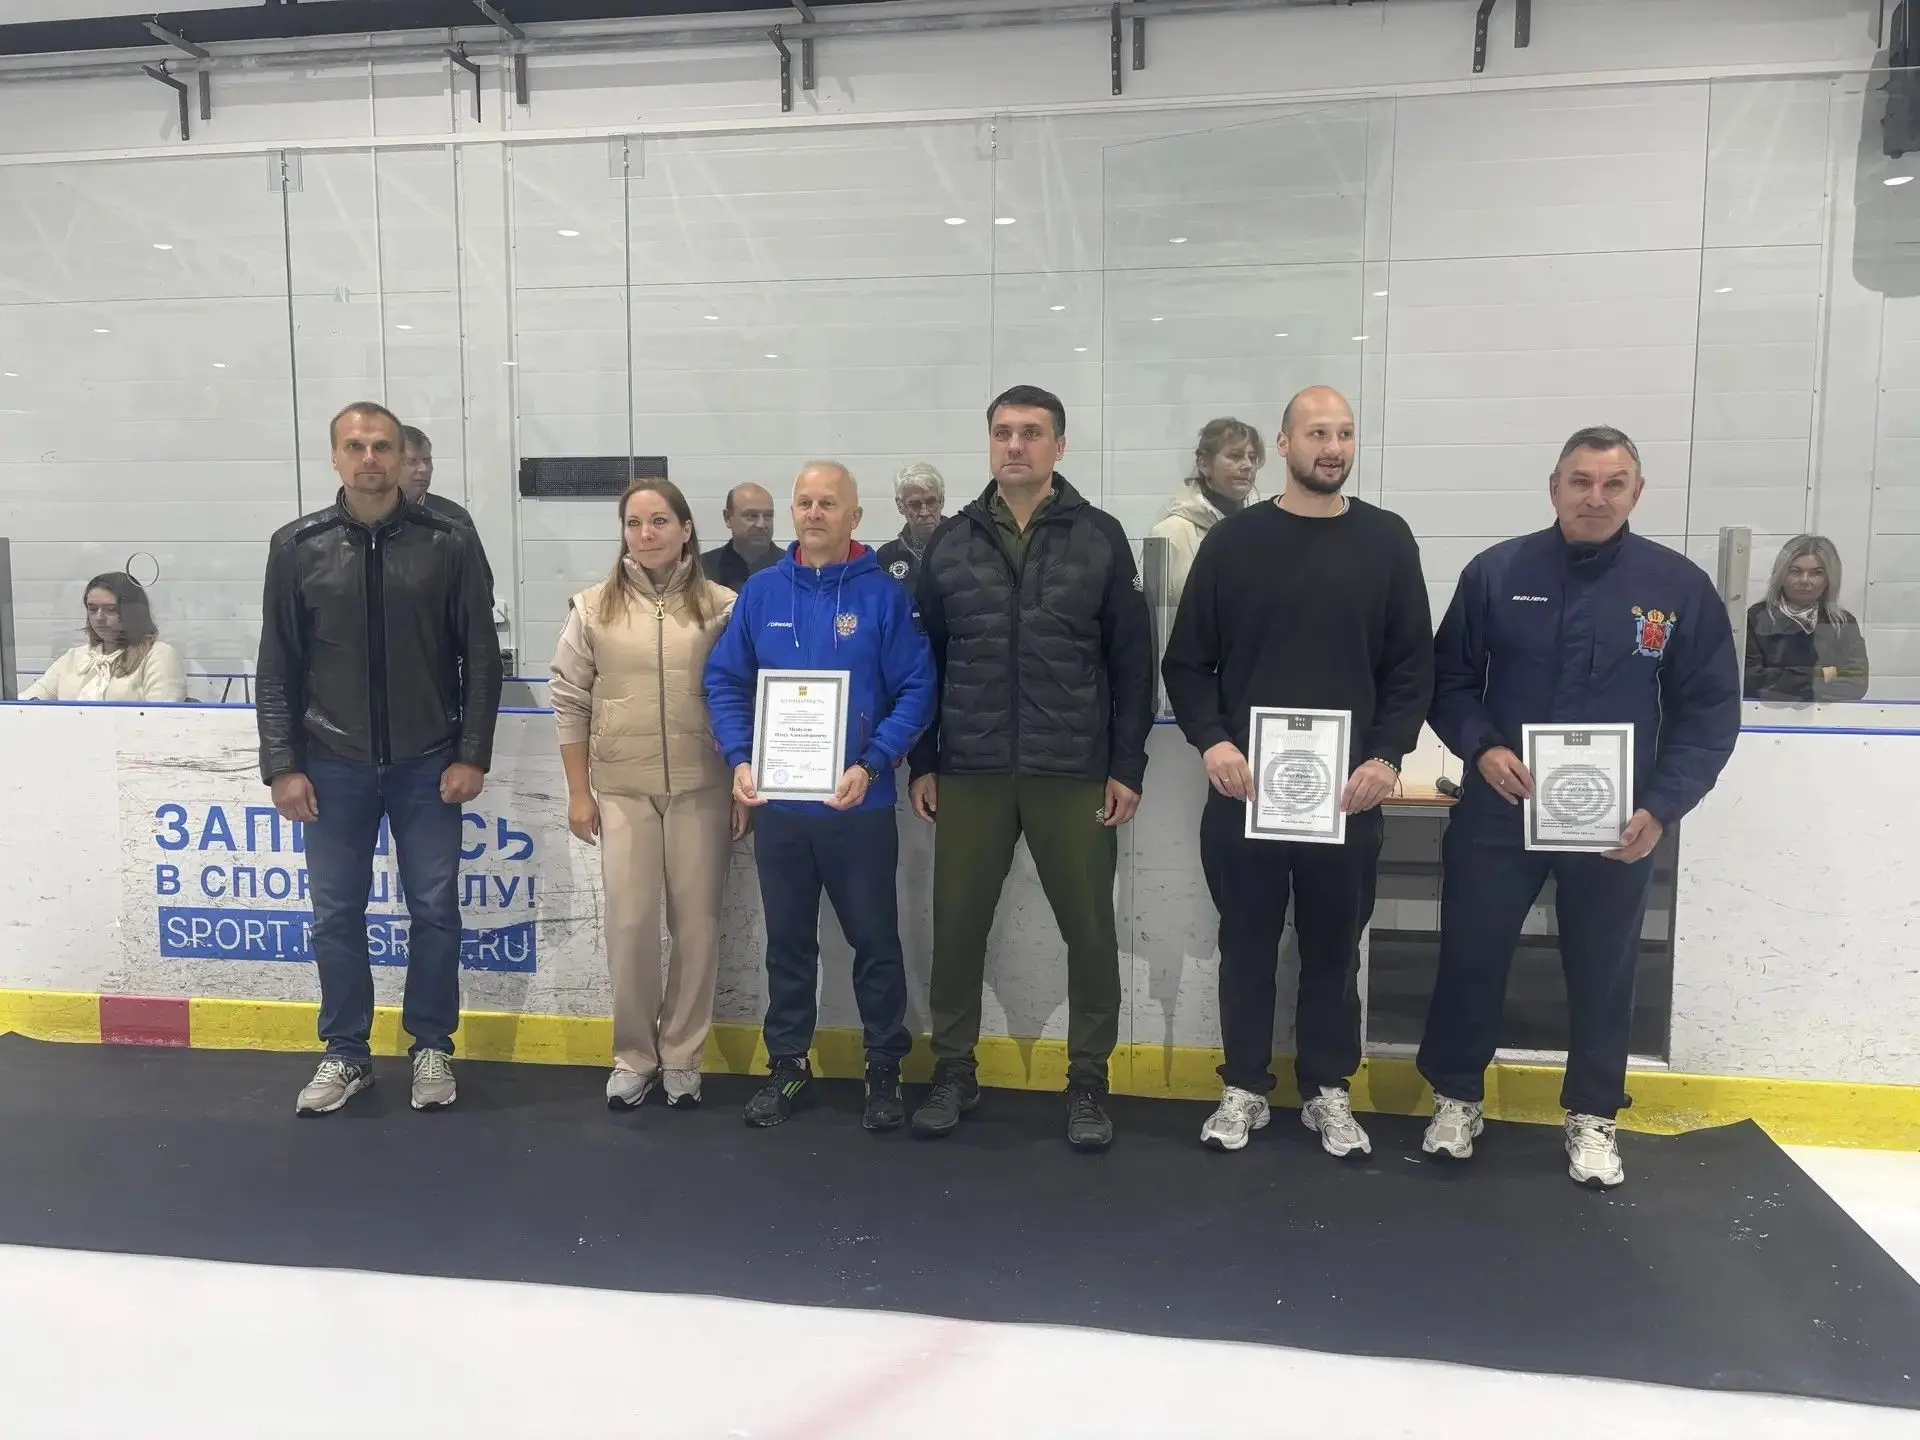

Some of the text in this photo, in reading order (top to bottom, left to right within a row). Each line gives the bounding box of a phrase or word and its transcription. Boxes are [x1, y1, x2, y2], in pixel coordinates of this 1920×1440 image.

[155, 803, 534, 861] ЗАПСЬ
[156, 864, 181, 895] В
[167, 916, 529, 962] SPORT.SR.RU
